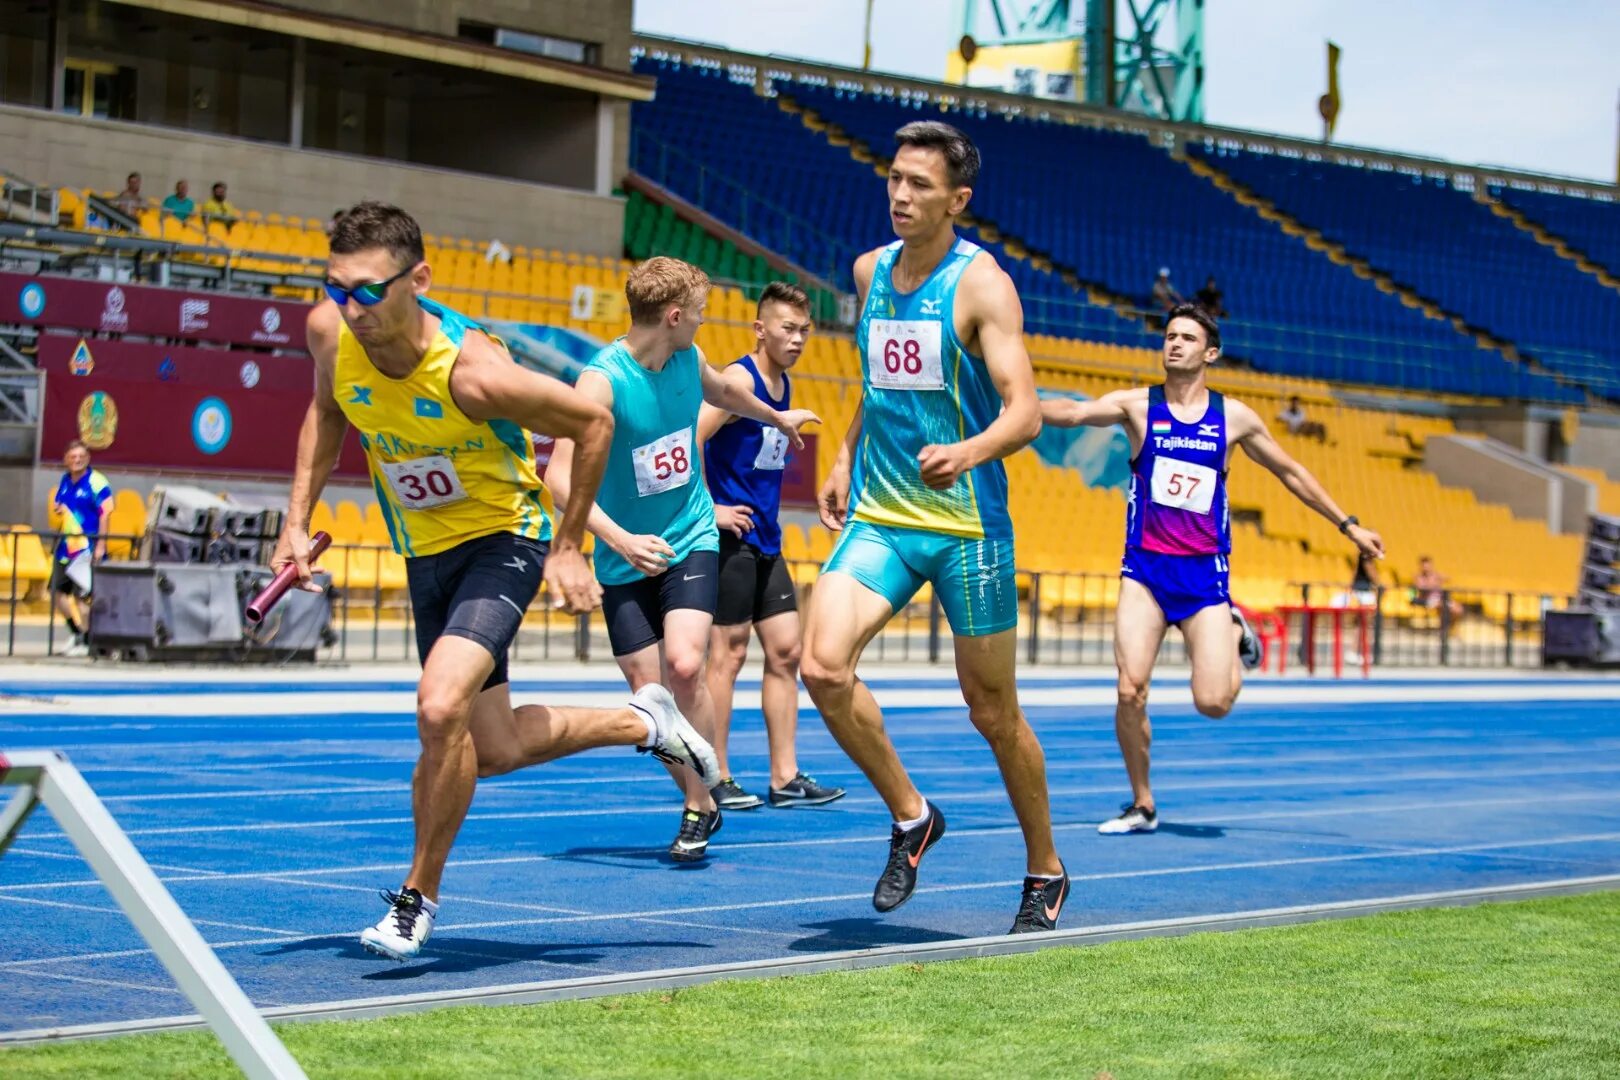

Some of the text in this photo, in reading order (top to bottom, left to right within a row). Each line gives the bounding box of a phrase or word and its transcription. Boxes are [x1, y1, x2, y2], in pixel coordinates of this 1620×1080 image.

[884, 338, 922, 374] 68
[1153, 436, 1217, 451] Tajikistan
[654, 446, 688, 480] 58
[398, 470, 453, 500] 30
[1167, 473, 1201, 499] 57
